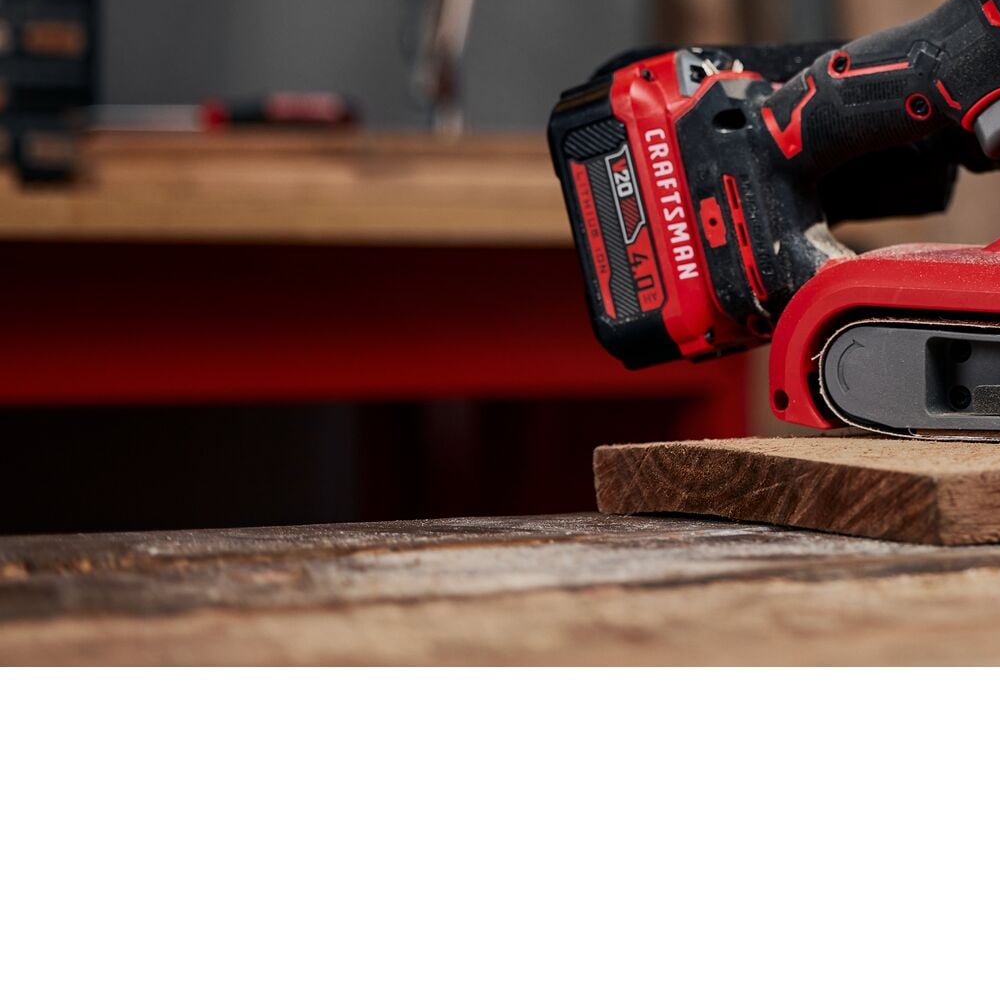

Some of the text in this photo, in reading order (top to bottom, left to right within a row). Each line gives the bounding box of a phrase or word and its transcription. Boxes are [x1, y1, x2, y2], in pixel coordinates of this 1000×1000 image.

[611, 158, 634, 198] V20
[644, 127, 699, 281] CRAFTSMAN
[595, 247, 608, 275] ION
[630, 252, 655, 291] 4.0
